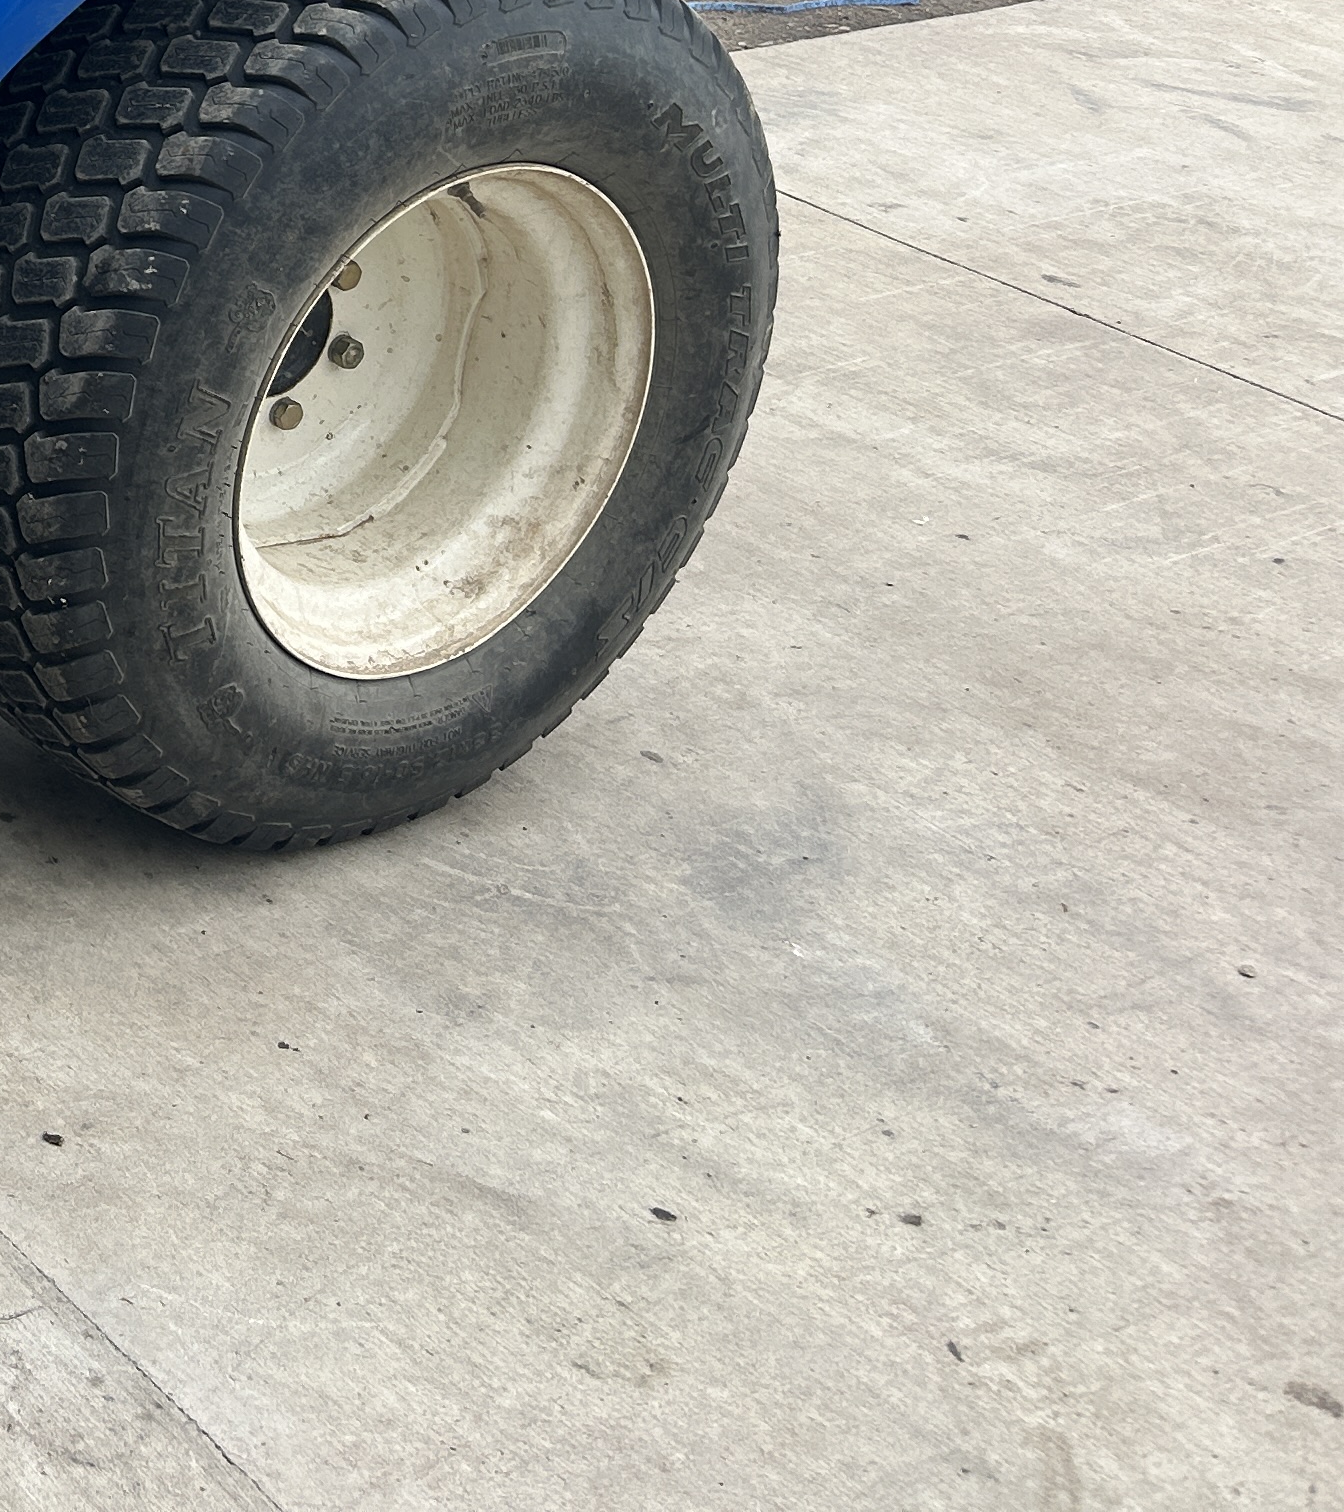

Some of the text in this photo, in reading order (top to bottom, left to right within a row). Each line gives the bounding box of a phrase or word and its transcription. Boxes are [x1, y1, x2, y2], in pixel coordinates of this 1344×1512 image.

[650, 102, 750, 264] MULTI
[695, 283, 752, 492] TRAC
[156, 379, 232, 666] TITAN
